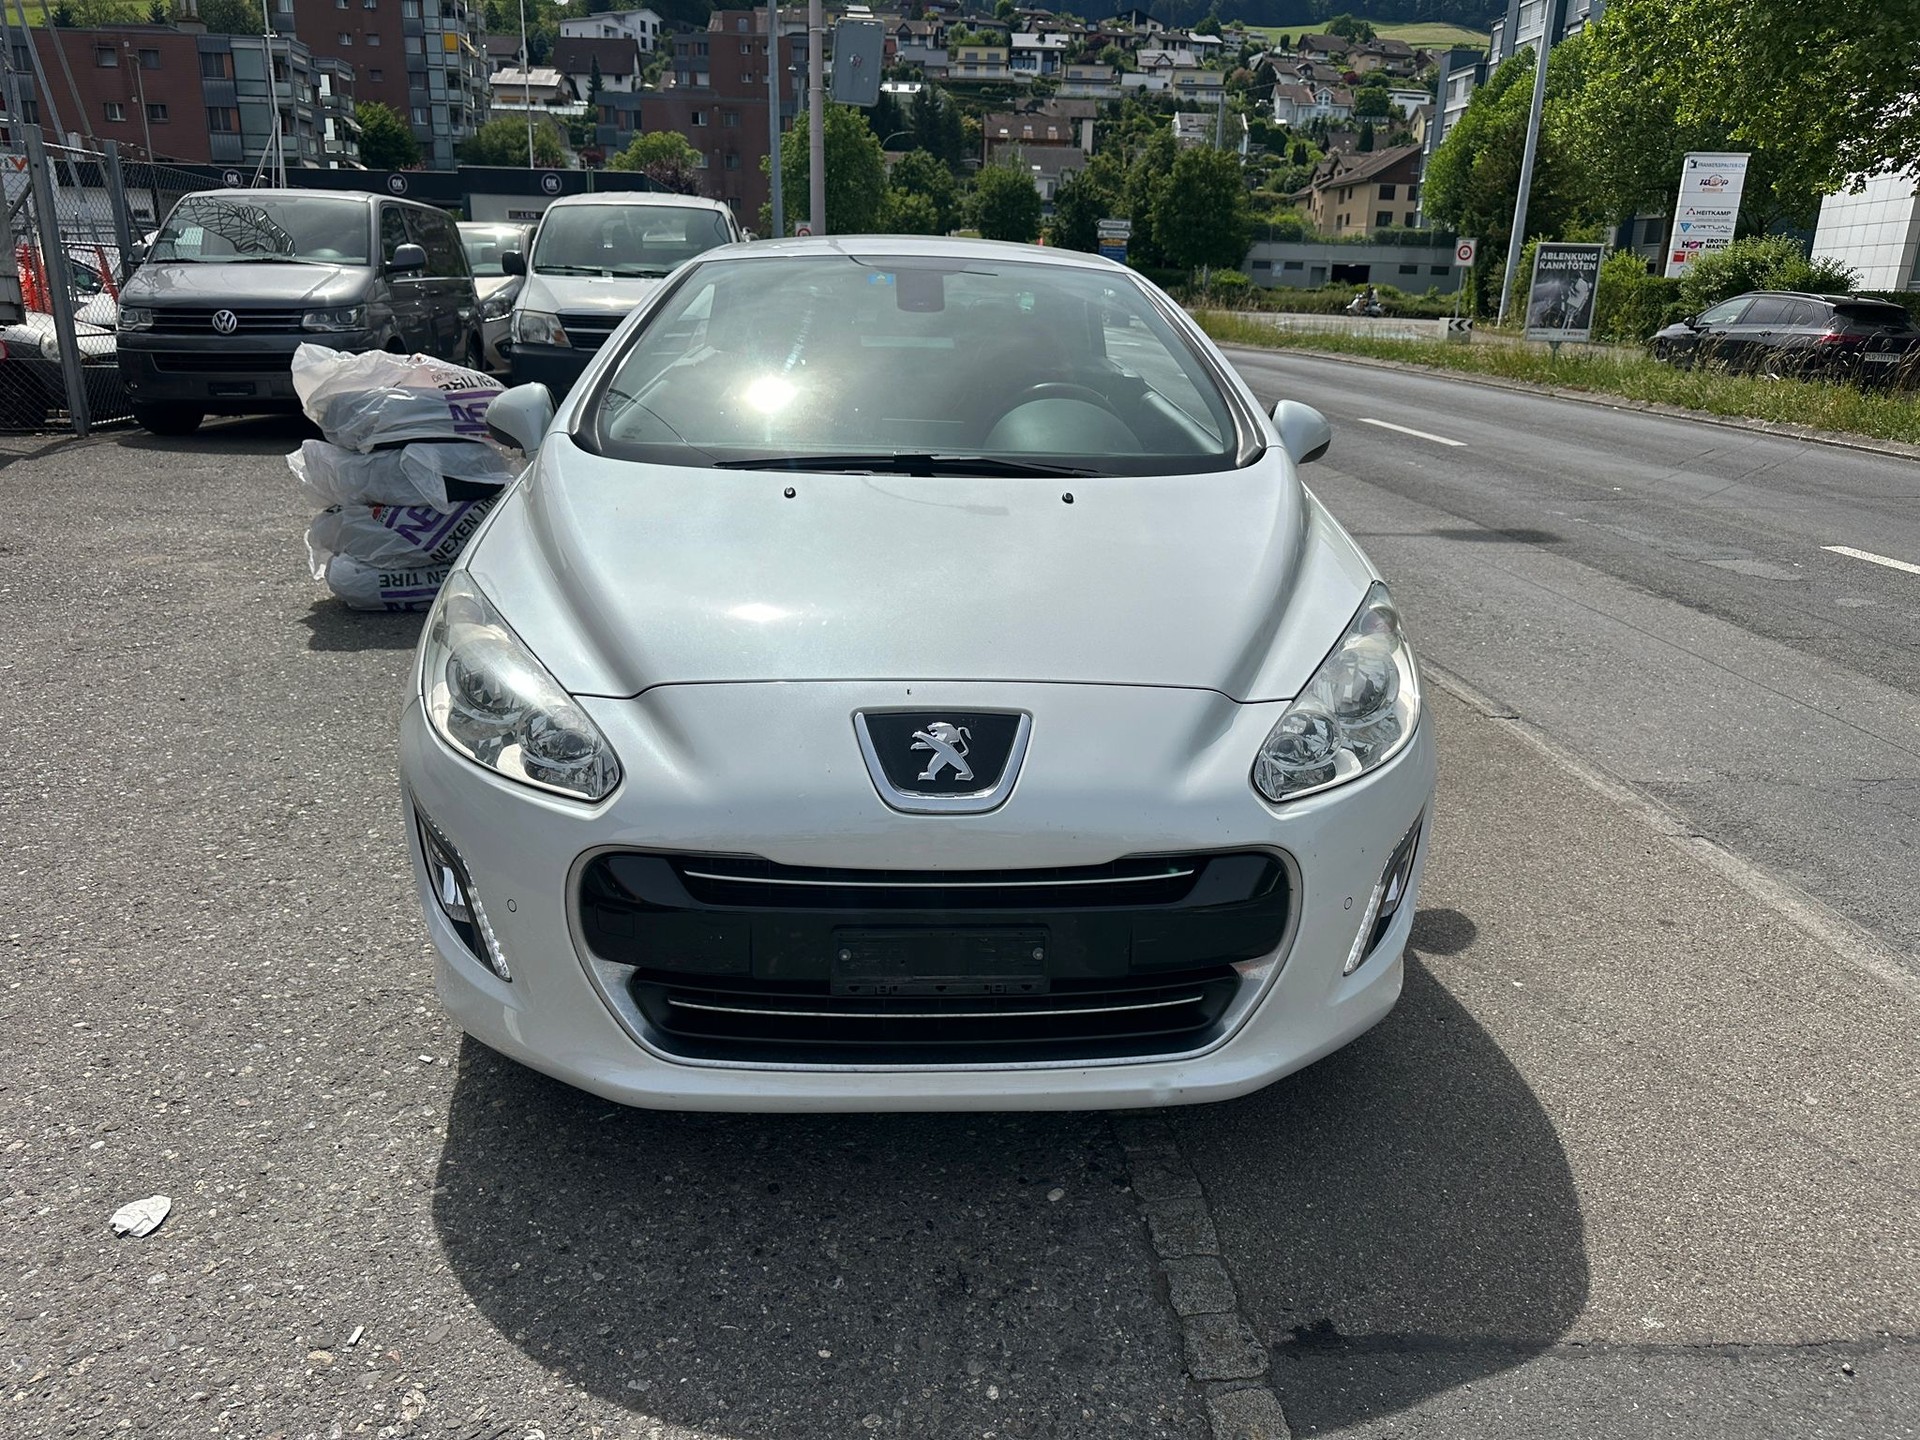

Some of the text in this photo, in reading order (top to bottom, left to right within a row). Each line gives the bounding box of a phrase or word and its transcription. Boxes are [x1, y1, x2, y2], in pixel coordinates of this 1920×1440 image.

[227, 174, 239, 184] OK
[392, 179, 403, 189] OK
[546, 178, 557, 189] OK
[1540, 252, 1598, 261] ABLENKUNG
[1539, 261, 1566, 270] KANN
[430, 513, 478, 561] NEXEN
[379, 573, 422, 587] TIRE
